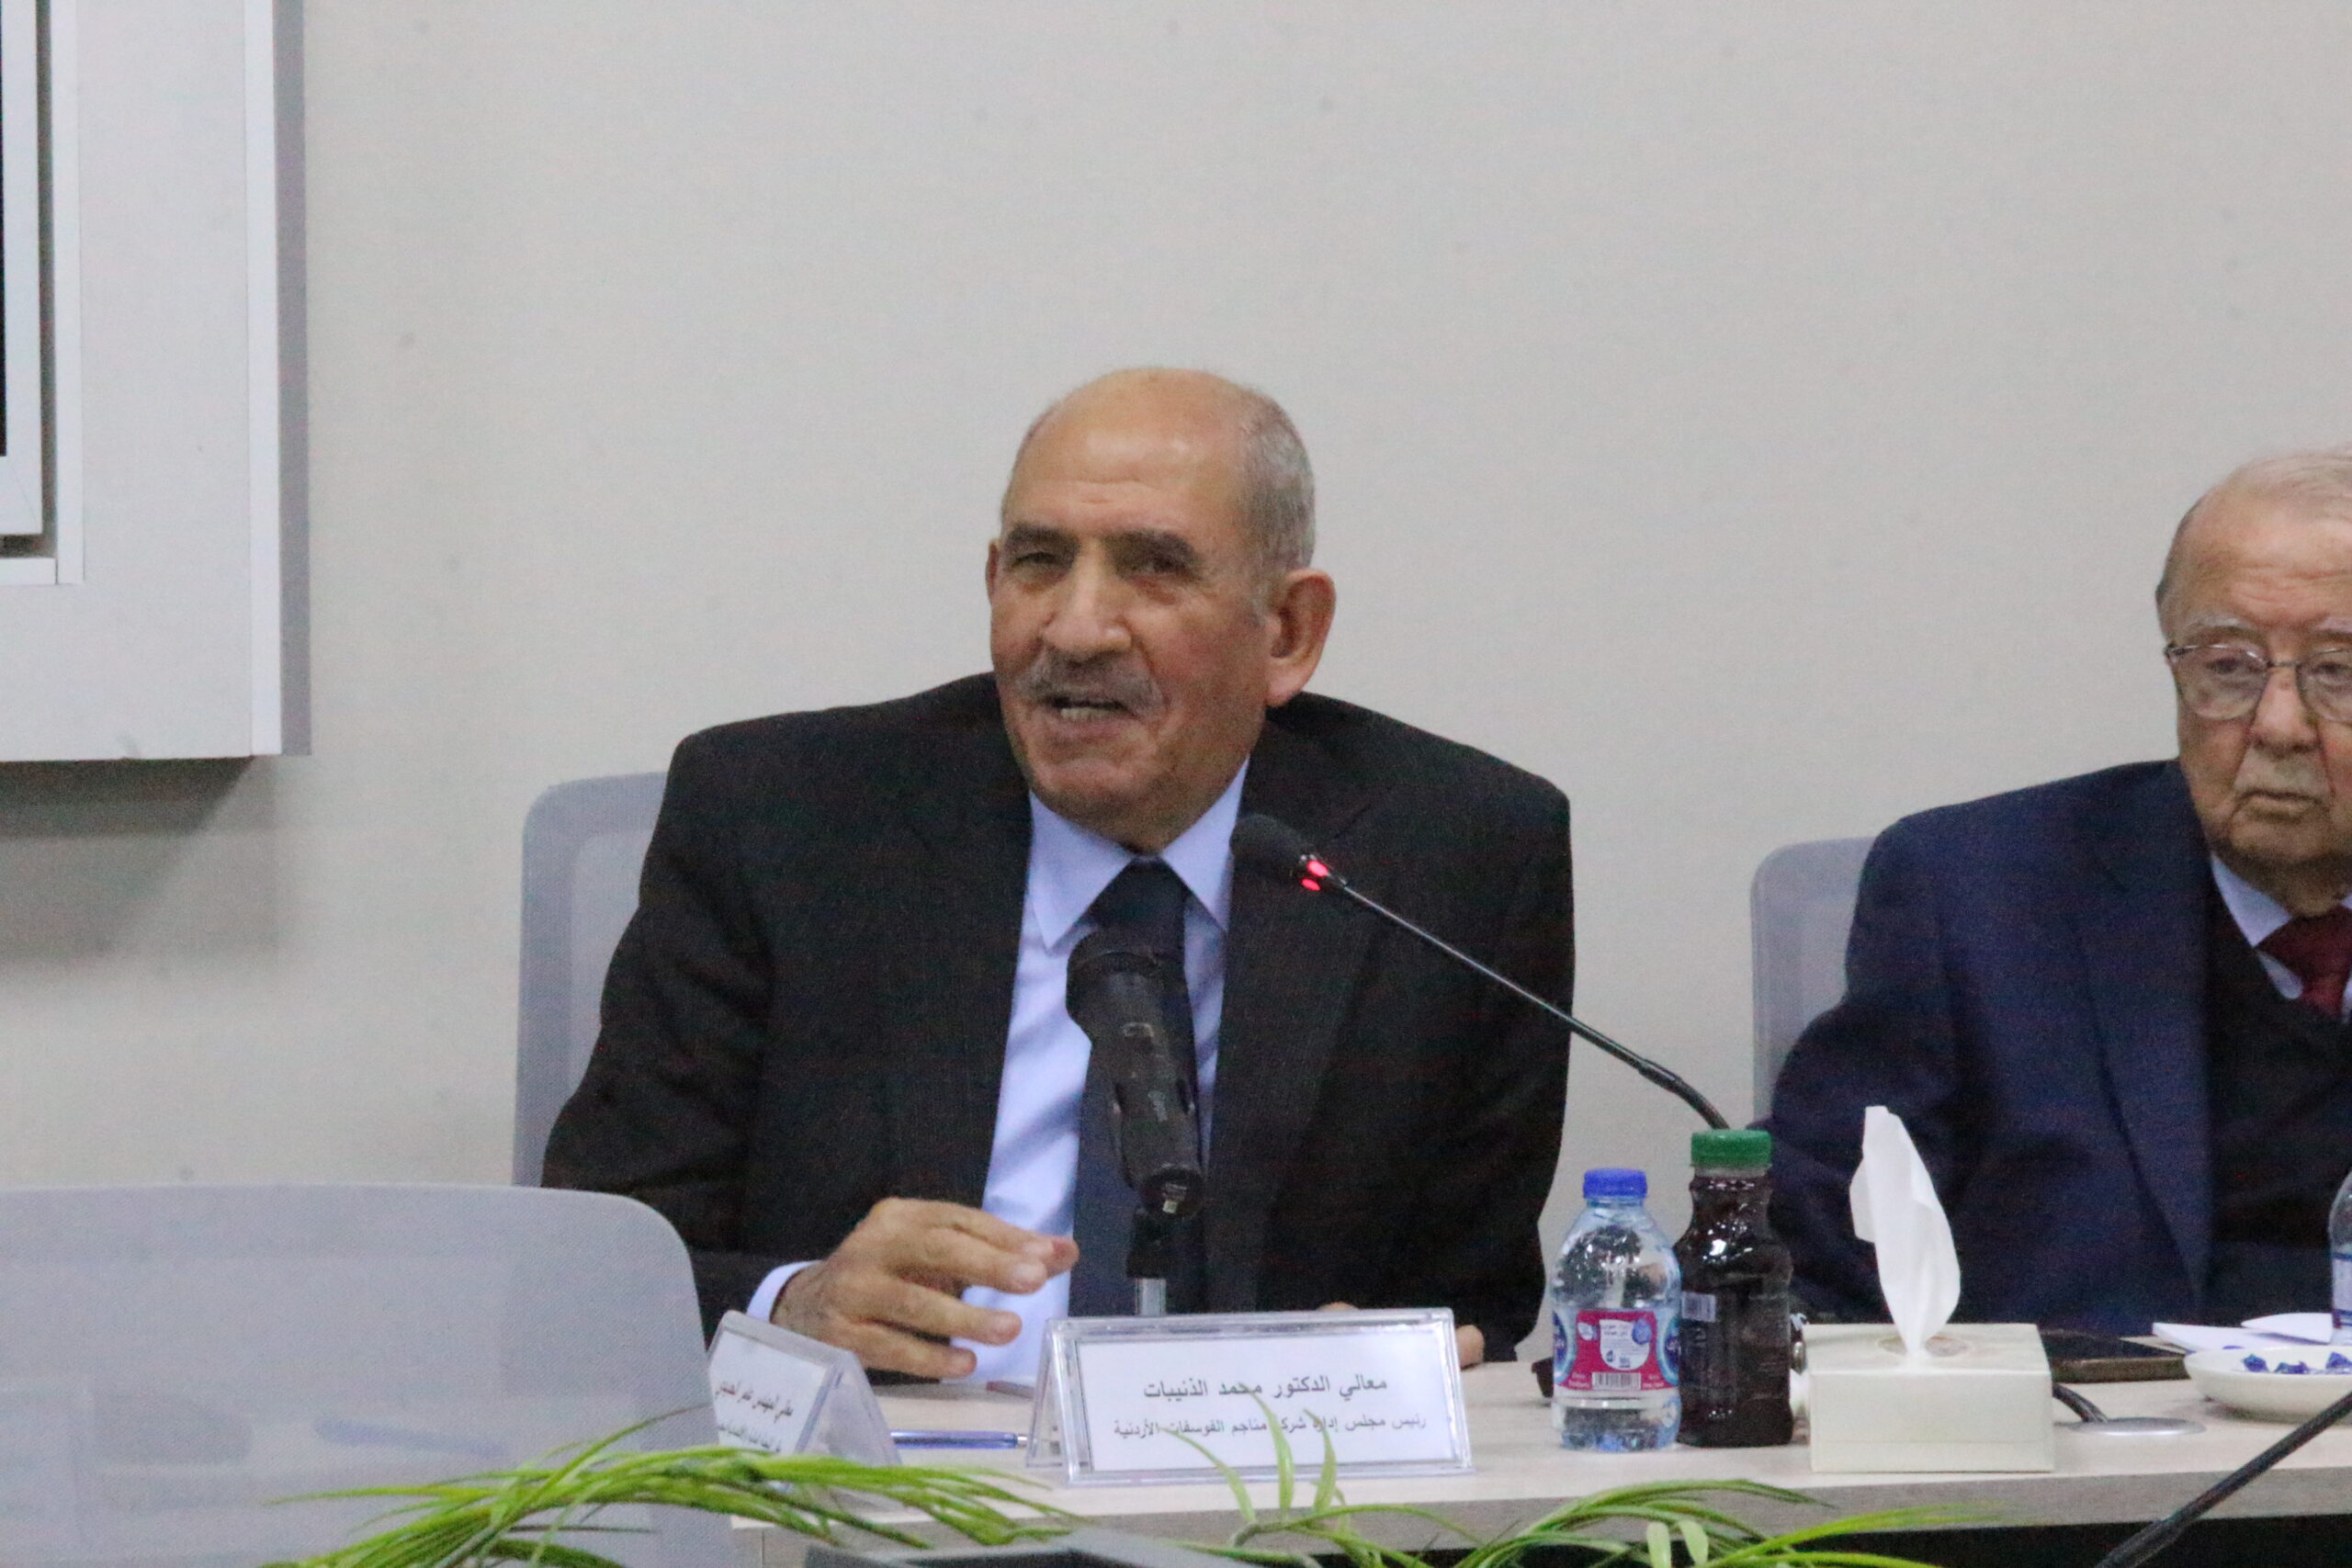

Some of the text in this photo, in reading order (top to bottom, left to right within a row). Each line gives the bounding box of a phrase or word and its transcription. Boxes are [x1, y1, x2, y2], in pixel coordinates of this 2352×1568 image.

[1143, 1374, 1387, 1402] معالي الدكتور محمد الذنيبات
[1114, 1418, 1159, 1438] الأردنية
[1231, 1417, 1268, 1435] مناجم
[1279, 1416, 1306, 1433] شرك
[1345, 1415, 1385, 1431] مجلس
[1391, 1414, 1427, 1431] رئيس
